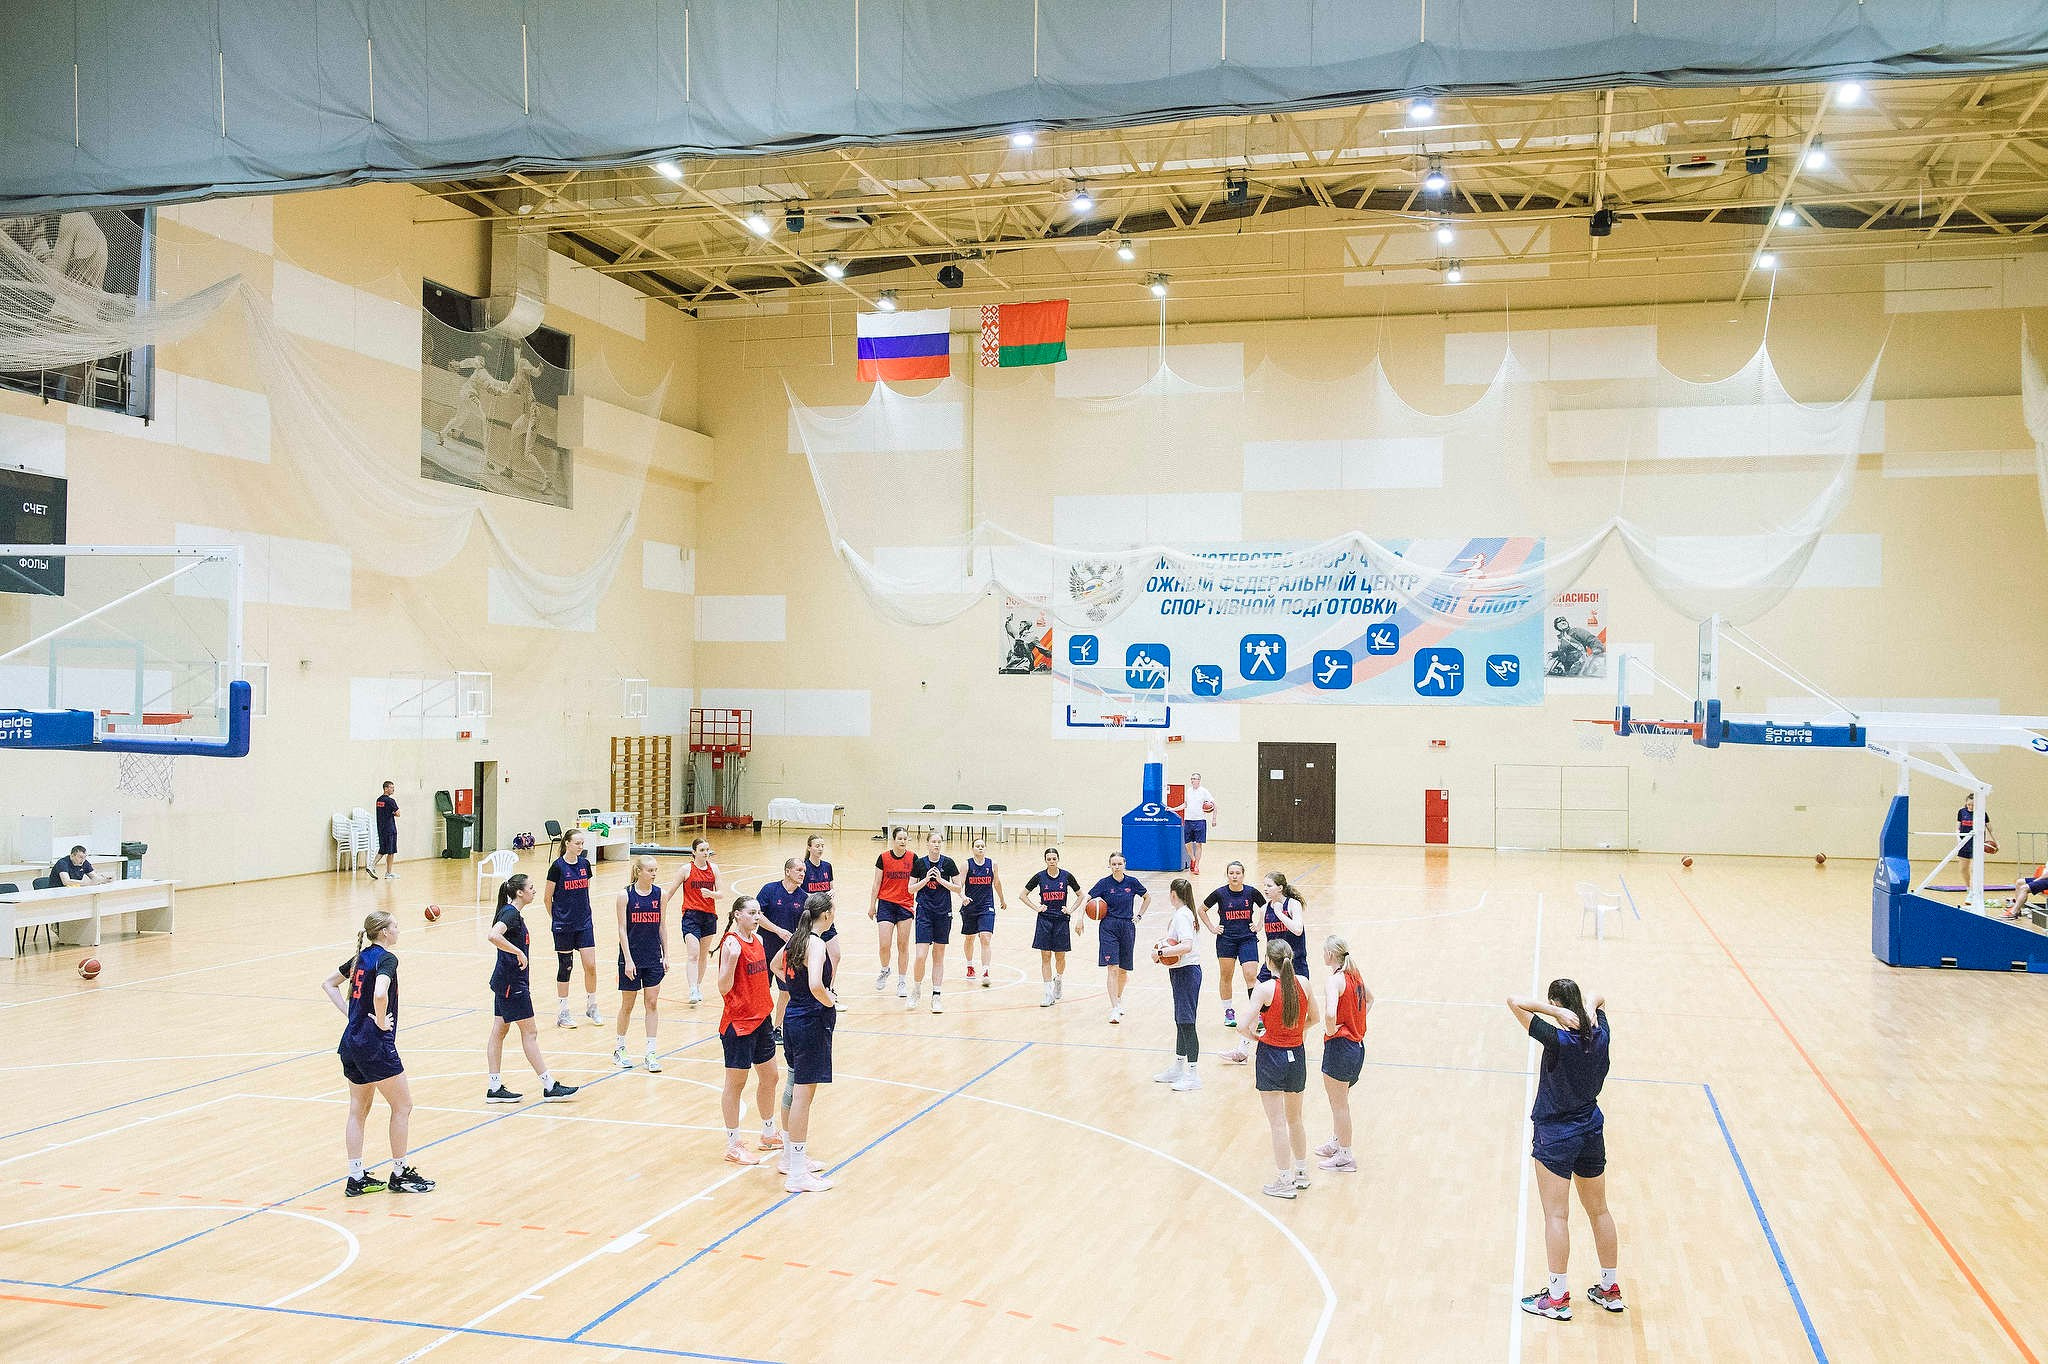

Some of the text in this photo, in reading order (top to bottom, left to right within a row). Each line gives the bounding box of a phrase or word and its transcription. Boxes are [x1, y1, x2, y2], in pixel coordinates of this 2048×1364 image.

[22, 502, 48, 515] СЧЕТ
[19, 558, 49, 570] ФОЛЫ
[1553, 592, 1599, 603] ПАСИБО!
[1160, 594, 1398, 617] СПОРТИВНОЙ ПОДГОТОВКИ
[0, 716, 33, 729] elde
[1765, 727, 1813, 736] Schelde
[1765, 735, 1813, 744] Sports
[631, 912, 660, 923] RUSSIA
